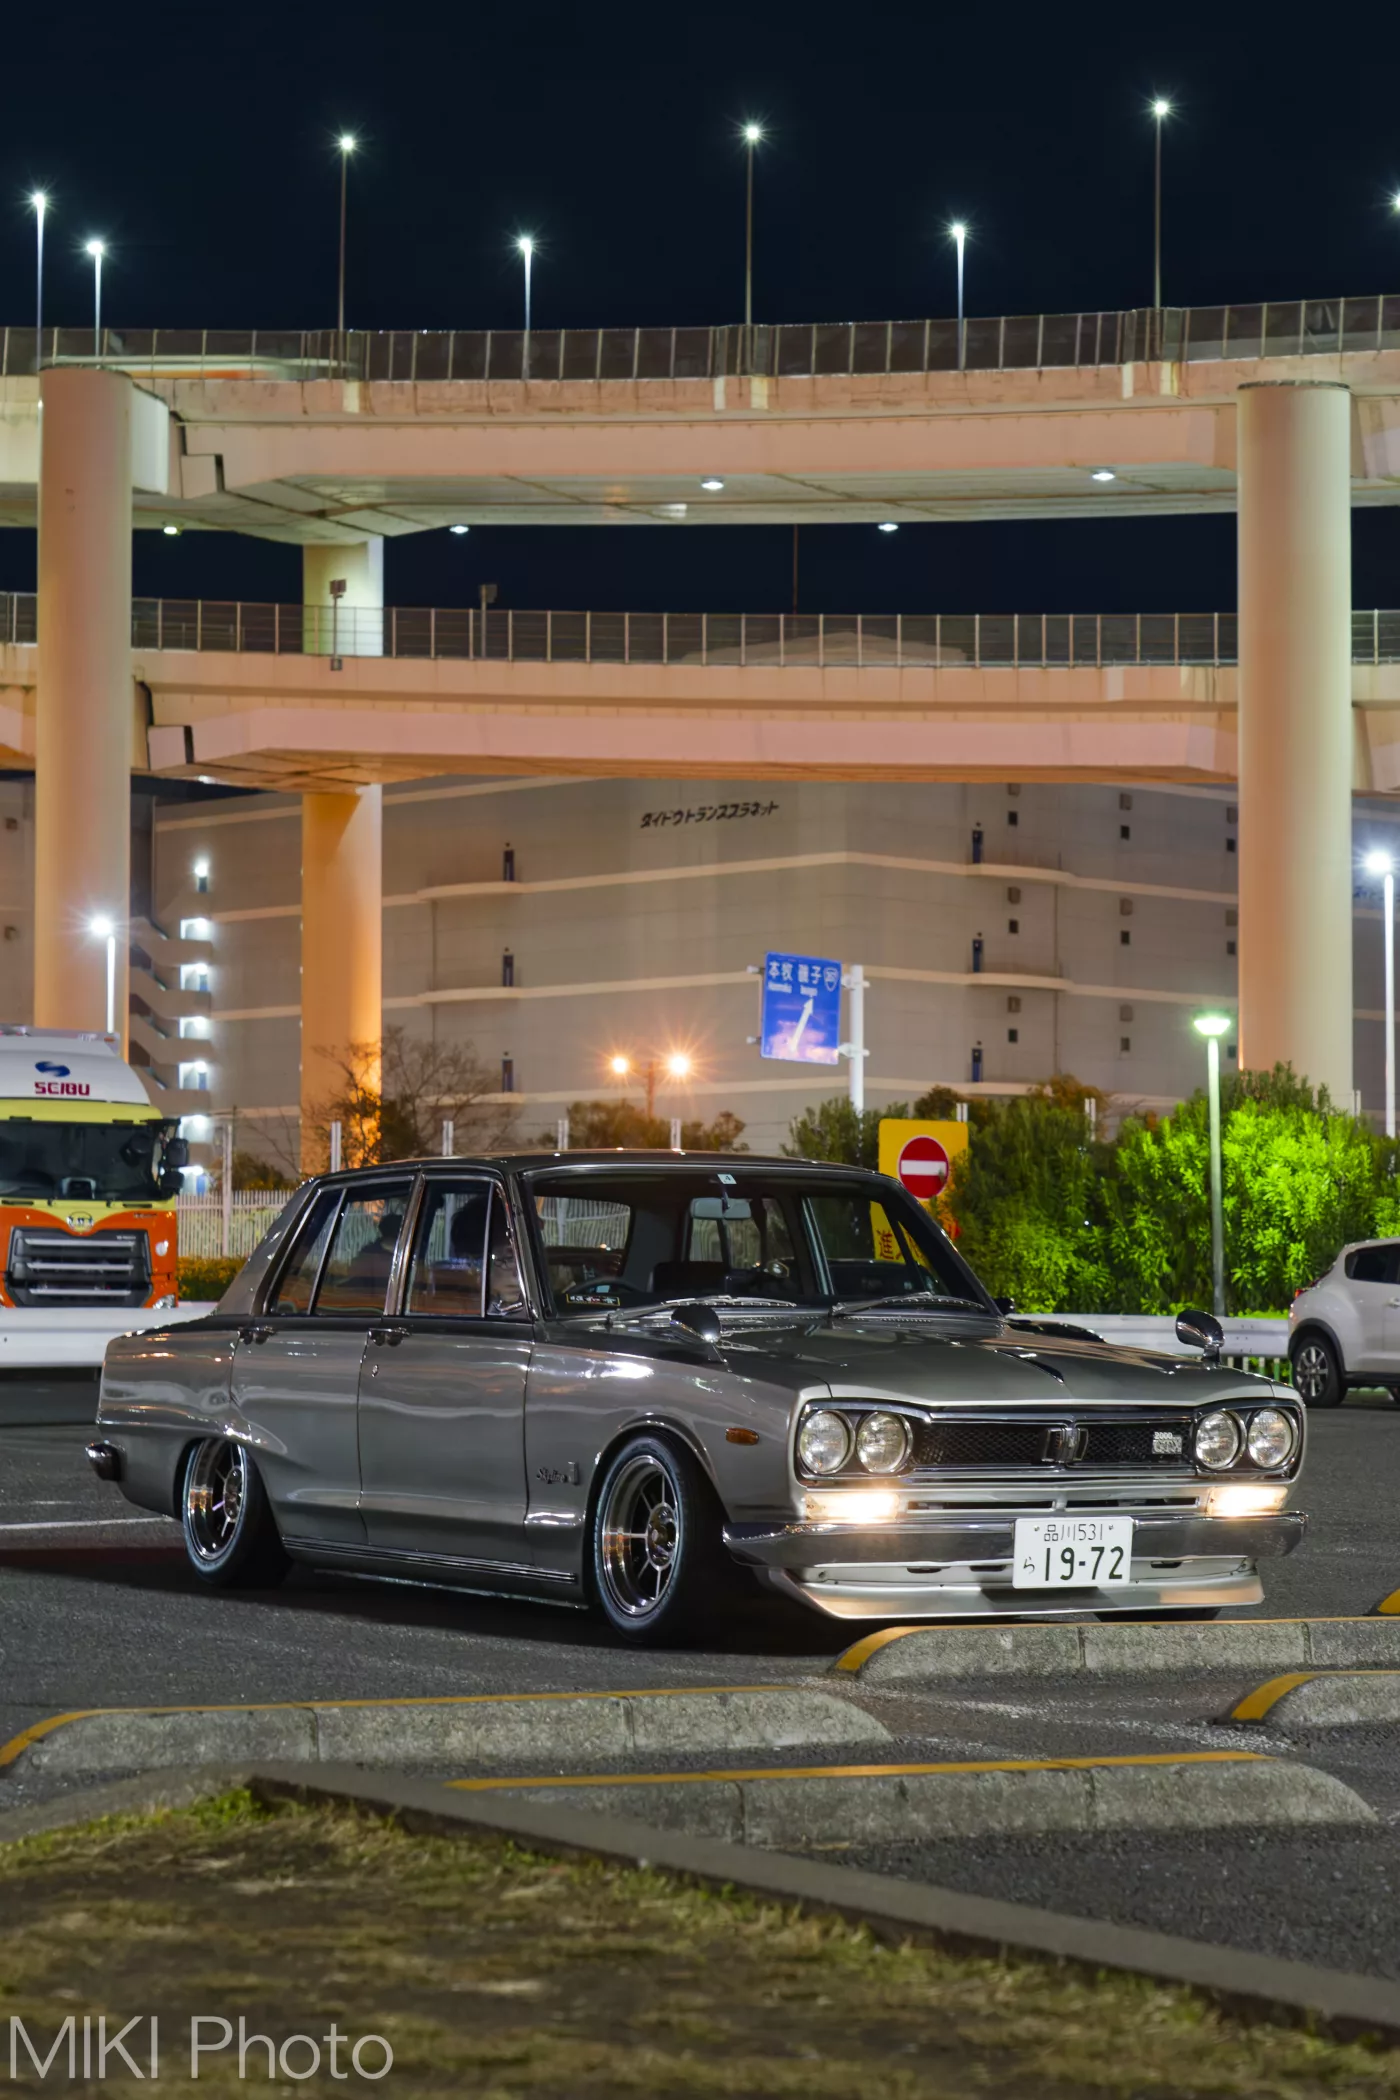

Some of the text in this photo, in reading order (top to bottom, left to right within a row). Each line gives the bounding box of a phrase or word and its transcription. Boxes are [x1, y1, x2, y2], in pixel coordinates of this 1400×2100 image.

[34, 1081, 90, 1096] SEIBU
[1022, 1545, 1125, 1582] ら 19-72
